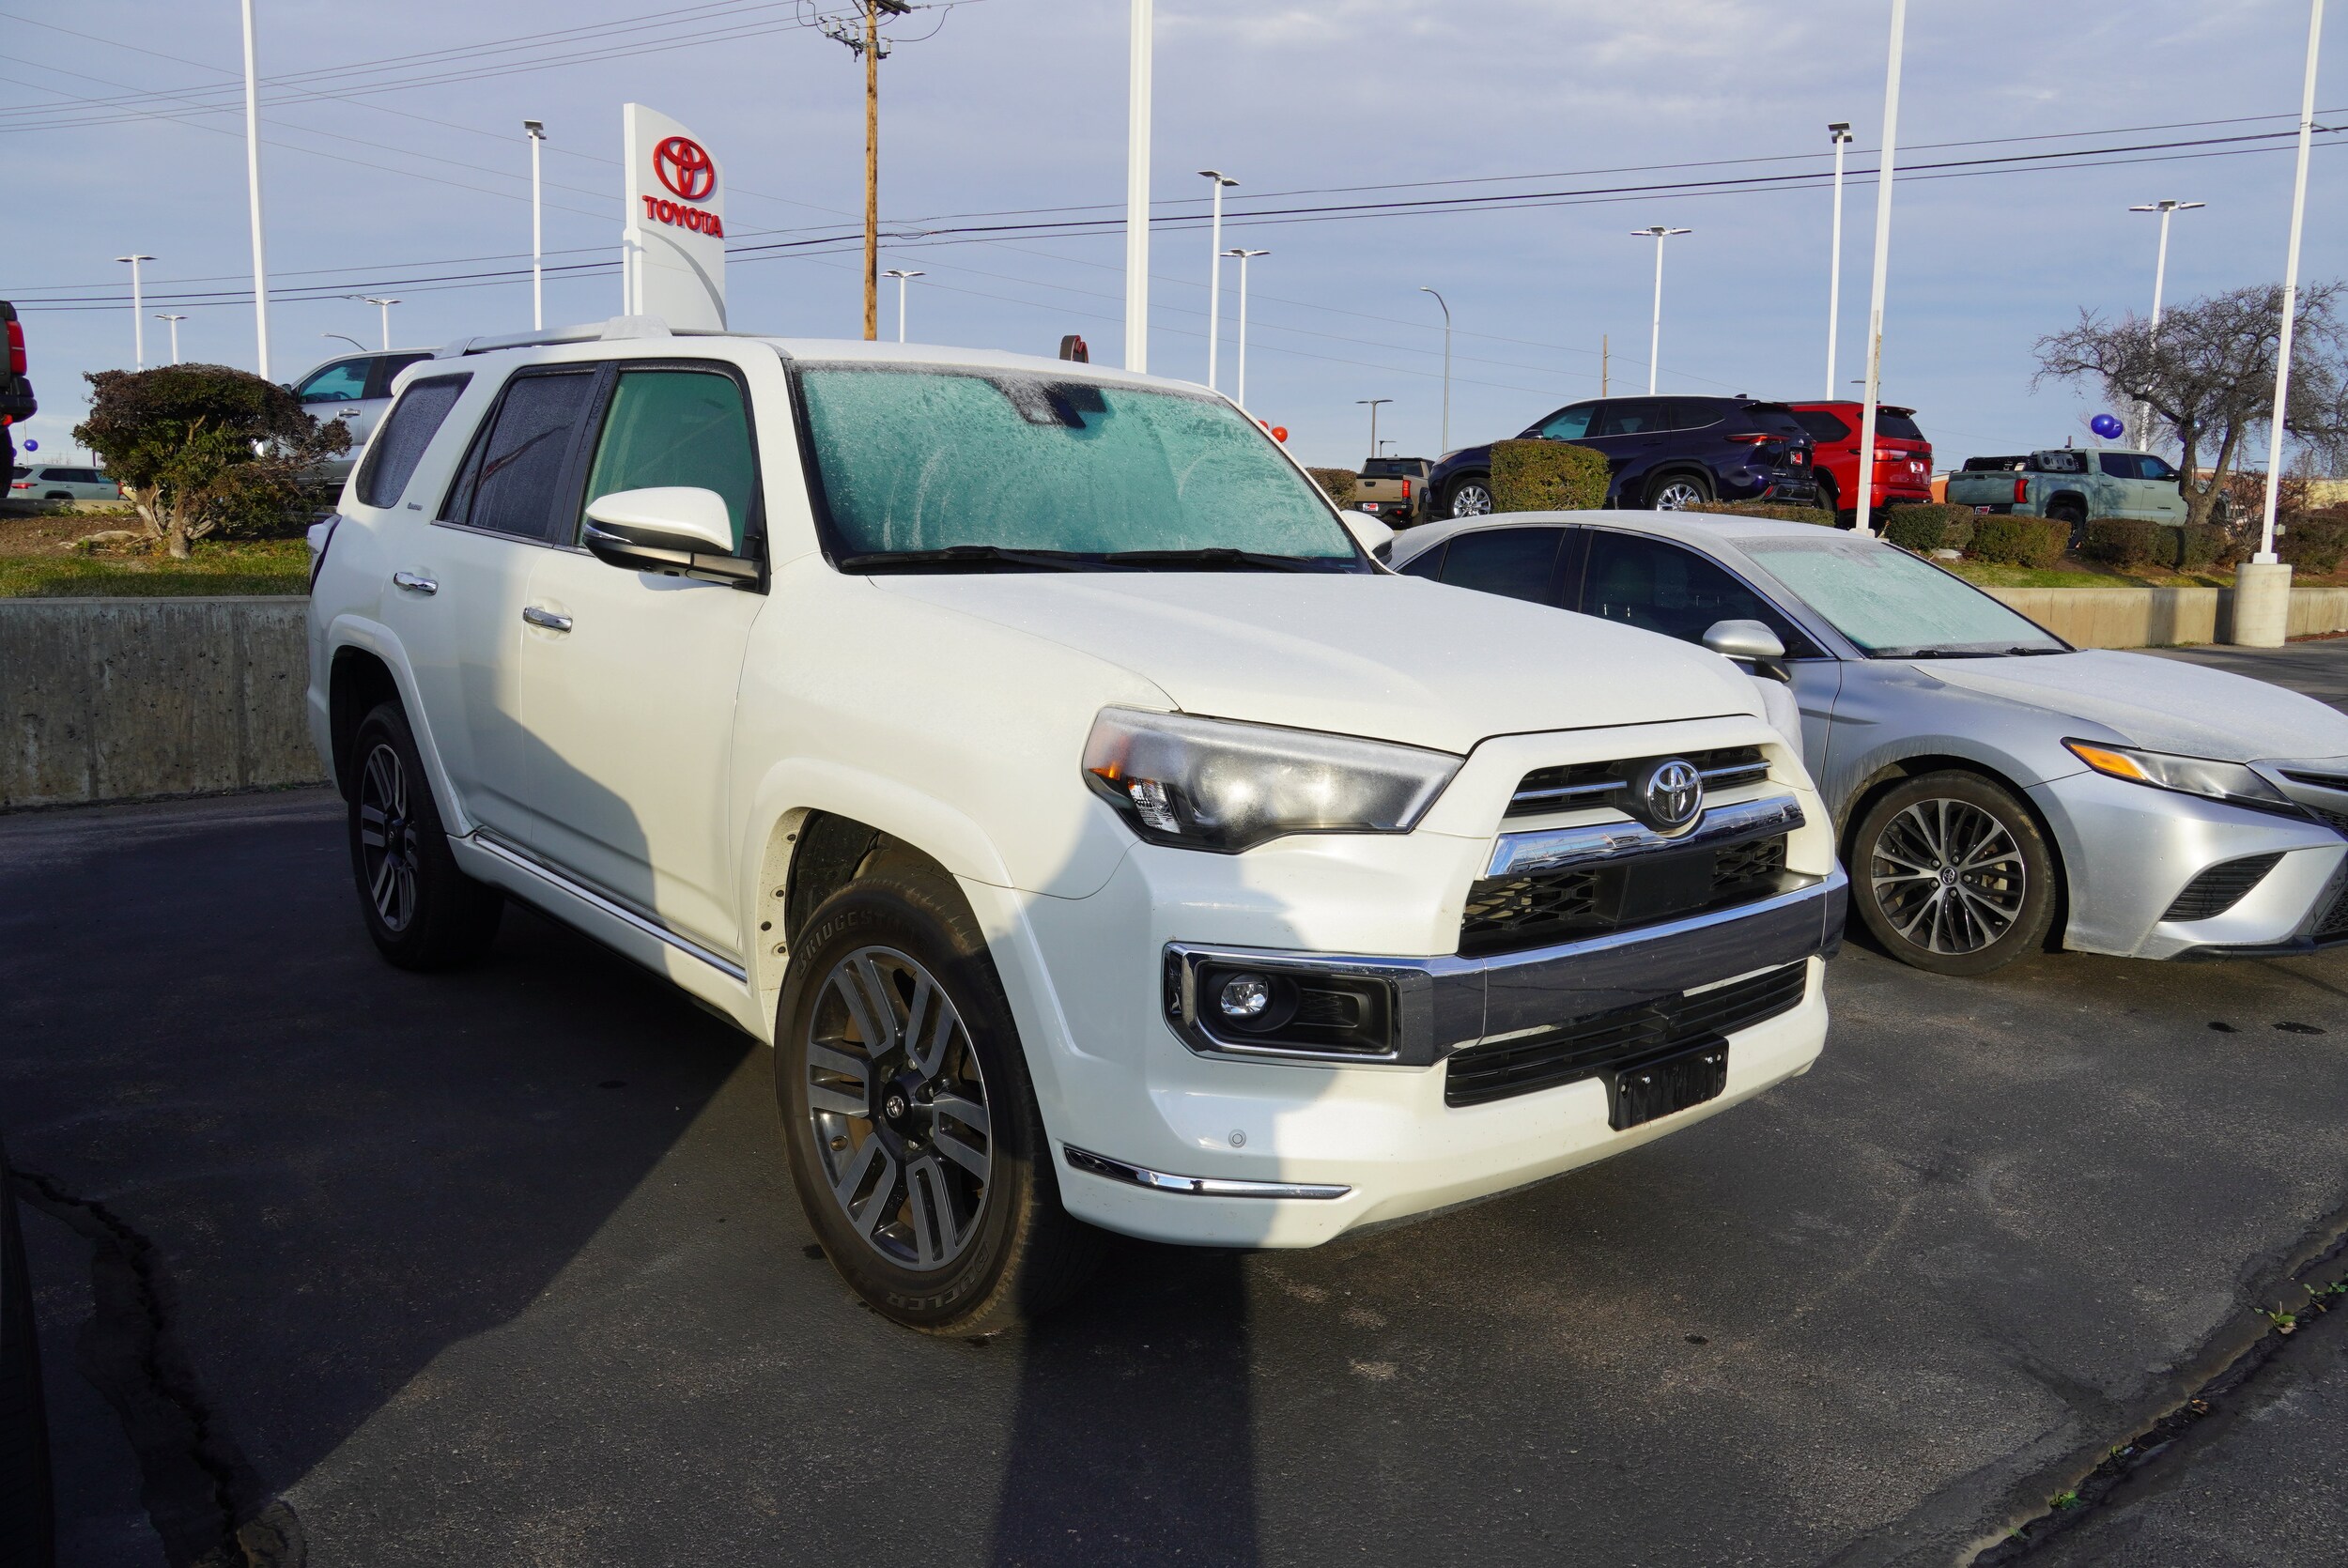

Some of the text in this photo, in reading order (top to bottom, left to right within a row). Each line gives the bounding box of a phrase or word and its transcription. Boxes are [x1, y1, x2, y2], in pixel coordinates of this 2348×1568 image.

[641, 194, 723, 238] TOYOTA
[796, 908, 917, 980] BRIDGEST
[885, 1240, 990, 1312] DUELER
